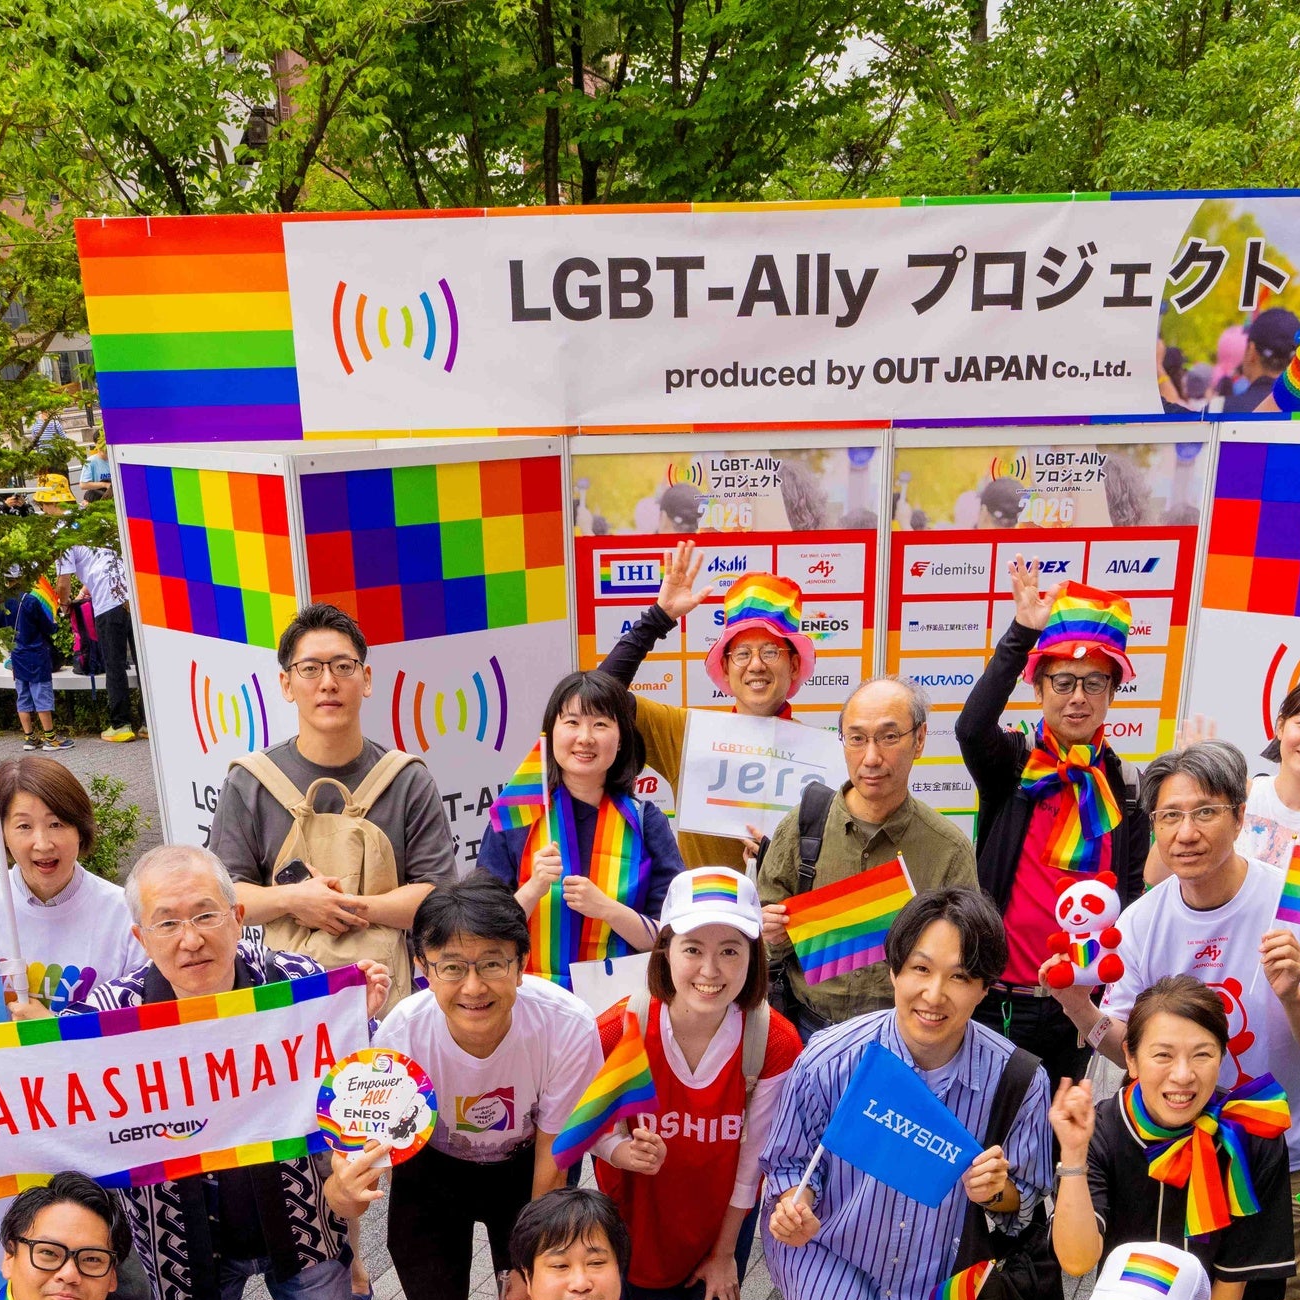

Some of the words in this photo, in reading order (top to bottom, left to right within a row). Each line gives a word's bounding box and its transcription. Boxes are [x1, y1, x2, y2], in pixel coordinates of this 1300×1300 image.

[509, 252, 877, 327] LGBT-Ally
[906, 236, 1291, 313] プロジェクト
[665, 362, 818, 394] produced
[825, 359, 866, 389] by
[874, 357, 938, 385] OUT
[943, 354, 1048, 384] JAPAN
[1052, 359, 1133, 380] Co.,Ltd.
[711, 458, 781, 472] LGBT-Ally
[1035, 453, 1107, 467] LGBT-Ally
[711, 474, 781, 488] プロジェクト
[1035, 468, 1107, 483] プロジェクト
[708, 555, 747, 573] Asahi
[931, 562, 985, 576] idemitsu
[1105, 560, 1141, 573] ANA
[617, 564, 655, 581] IHI
[801, 619, 849, 632] ENEOS
[1128, 626, 1152, 635] OME
[804, 675, 849, 686] YOCERA
[921, 674, 974, 686] KURABO
[1115, 685, 1137, 693] PAN
[911, 781, 972, 792] 住友金属鉱山
[242, 926, 263, 945] JAP
[347, 1076, 403, 1095] Empower
[360, 1088, 393, 1107] All!
[343, 1108, 390, 1120] ENEOS
[348, 1122, 385, 1133] ALLY!
[637, 1111, 744, 1143] OSHIB
[862, 1097, 963, 1166] LAWSON
